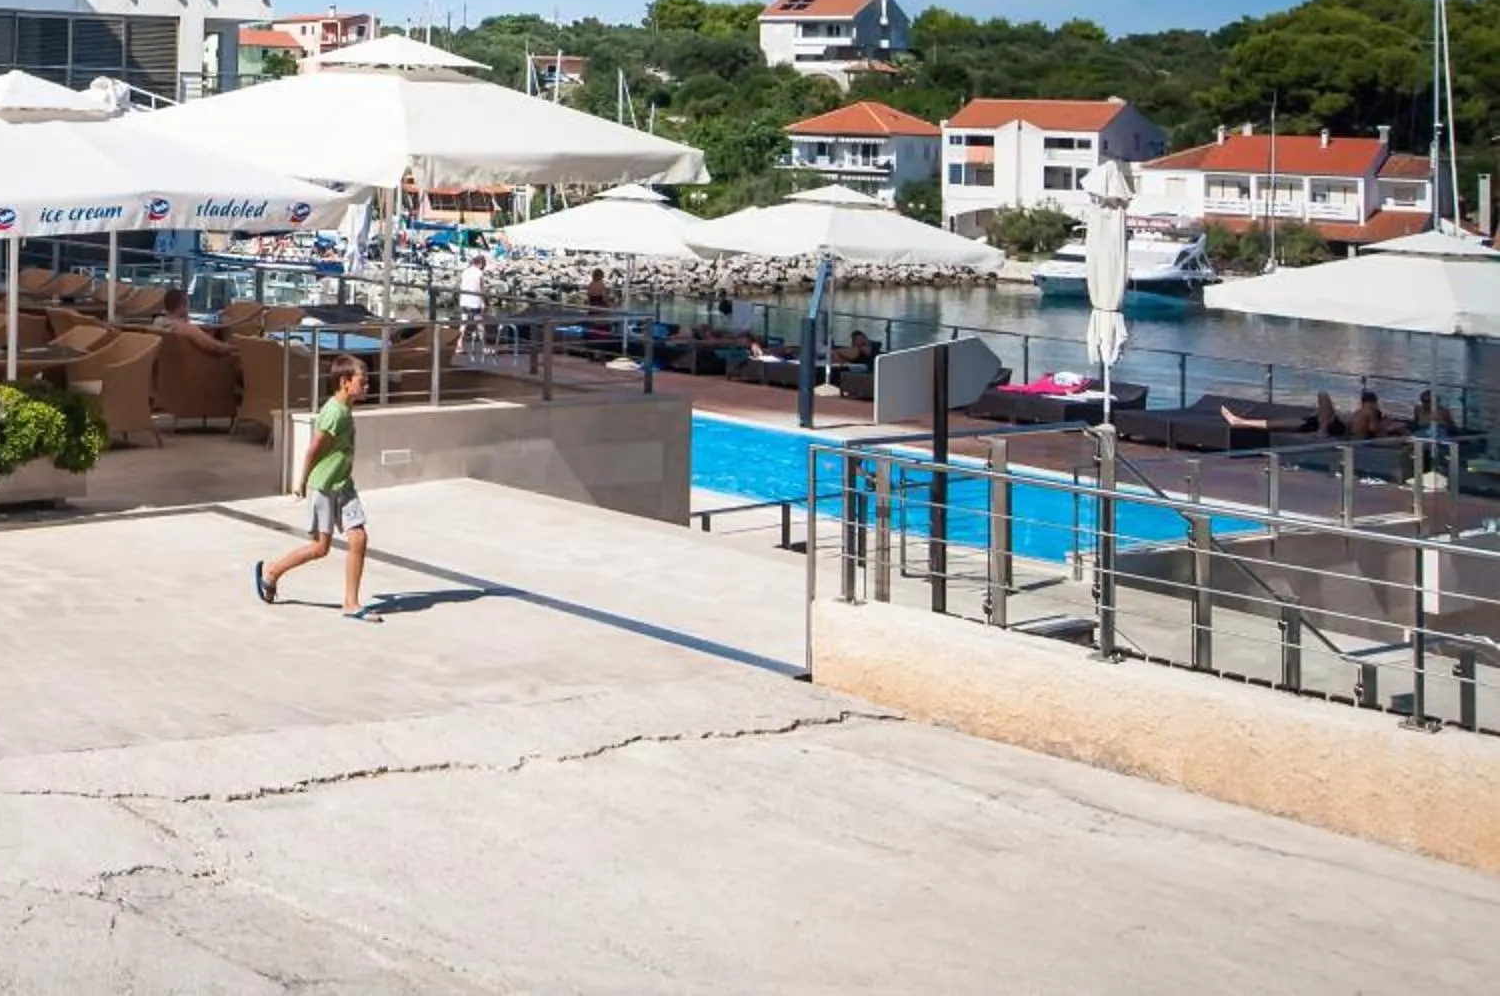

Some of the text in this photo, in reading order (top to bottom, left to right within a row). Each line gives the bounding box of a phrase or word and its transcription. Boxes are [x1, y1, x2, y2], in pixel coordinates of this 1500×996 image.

[40, 204, 123, 223] ice cream
[196, 198, 269, 218] sladoled
